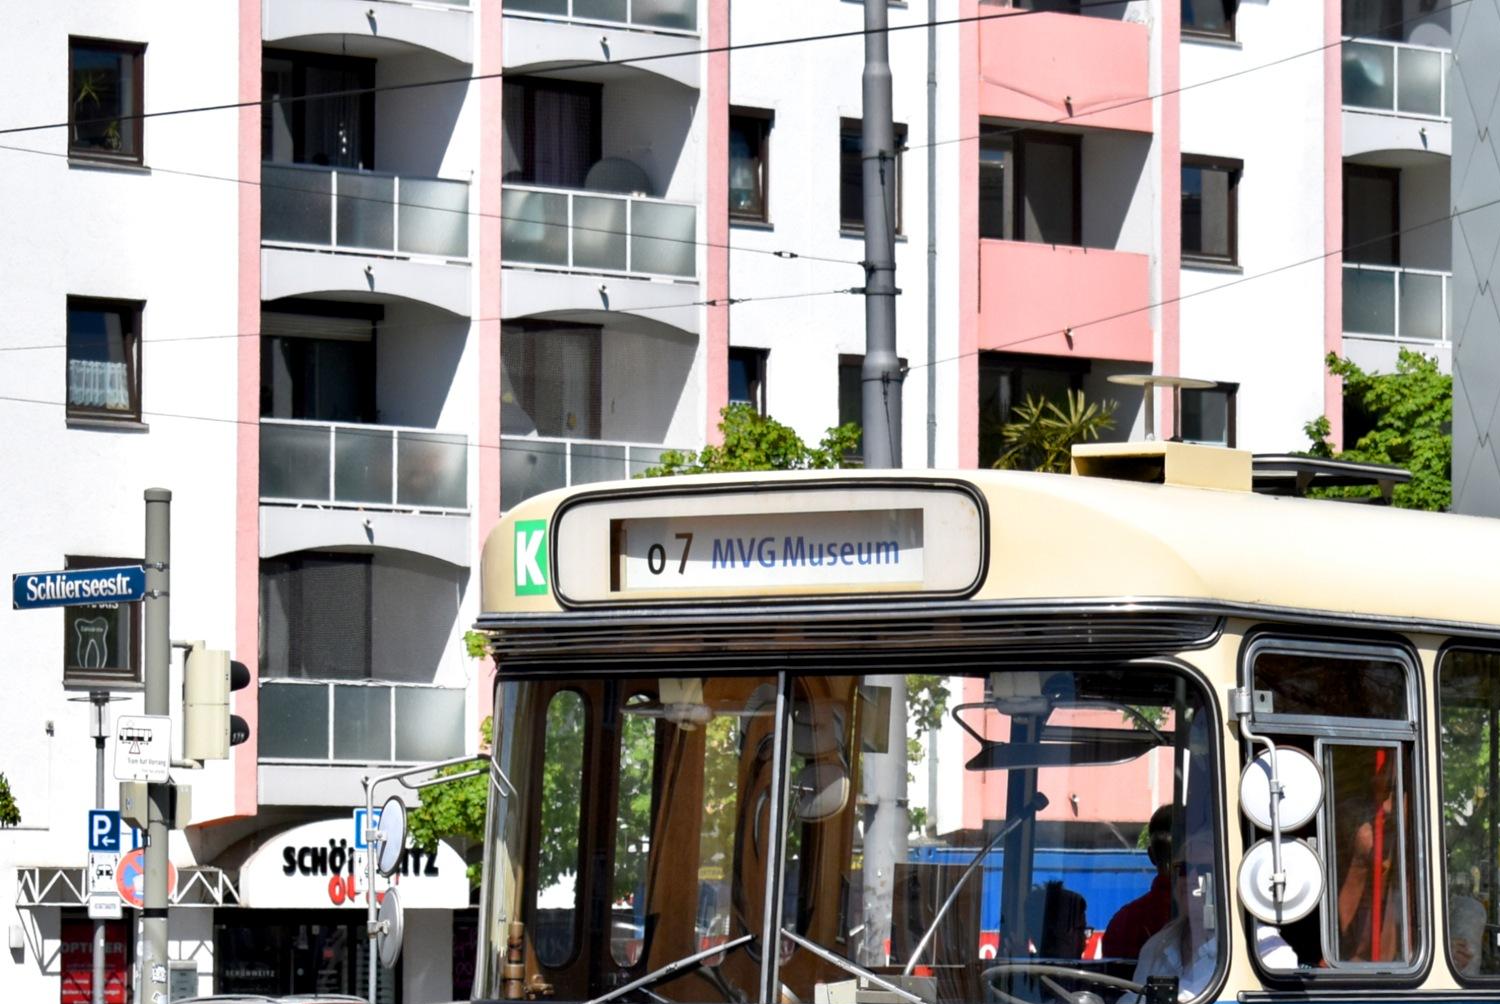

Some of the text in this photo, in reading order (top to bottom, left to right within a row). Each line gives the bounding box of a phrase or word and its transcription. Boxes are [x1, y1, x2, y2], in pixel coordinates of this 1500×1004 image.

[516, 529, 547, 587] K
[712, 536, 776, 569] MVG
[782, 535, 900, 567] Museum
[26, 573, 133, 602] Schlierseestr.
[93, 814, 112, 847] P
[282, 837, 440, 877] SCHÖITZ
[61, 943, 123, 954] OPTIER
